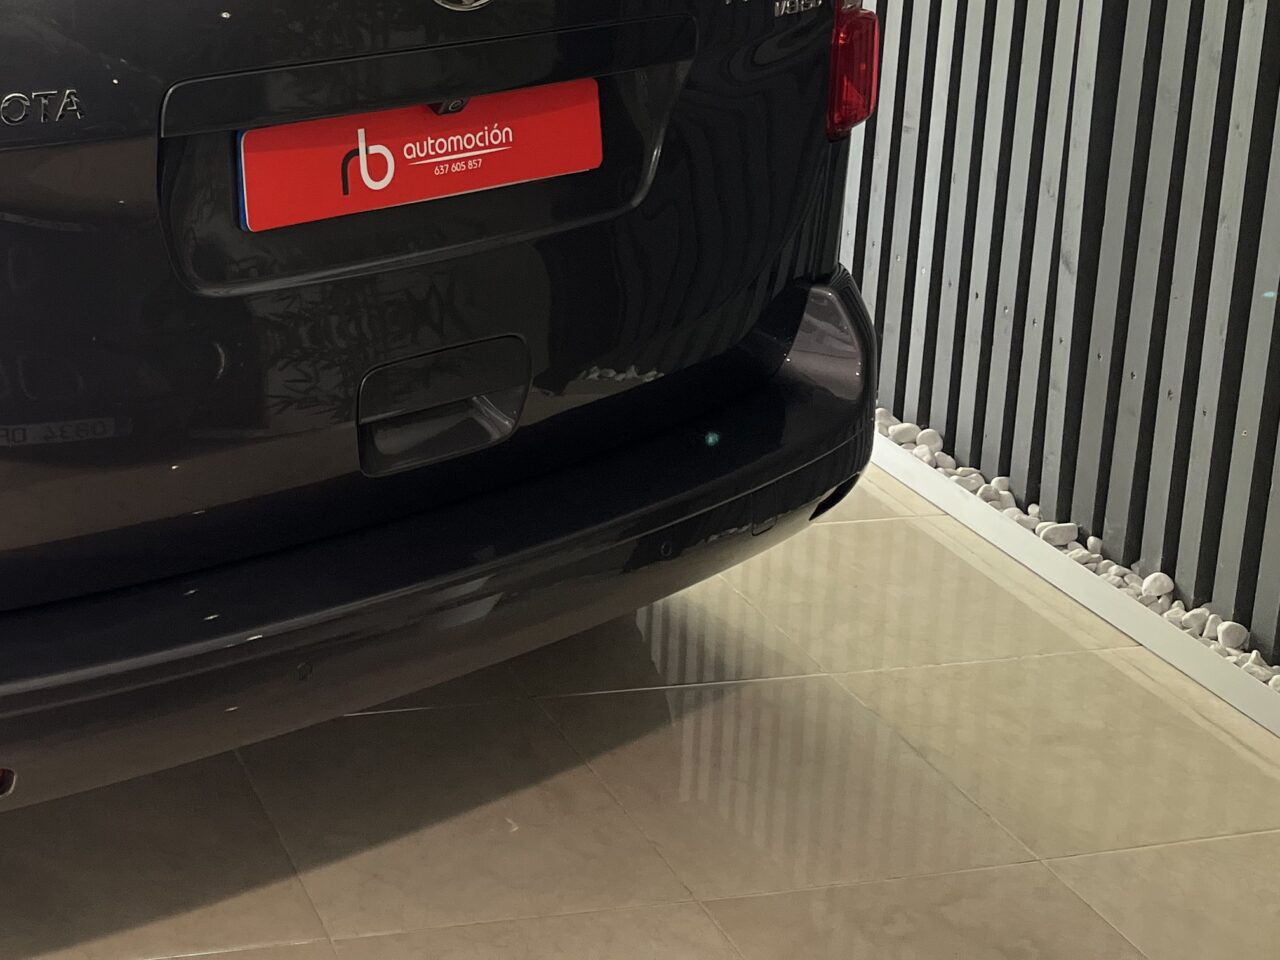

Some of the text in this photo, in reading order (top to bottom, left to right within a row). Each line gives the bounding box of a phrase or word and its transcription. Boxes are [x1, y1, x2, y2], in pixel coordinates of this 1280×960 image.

[403, 123, 513, 160] automoción
[434, 158, 483, 176] 637 605 857
